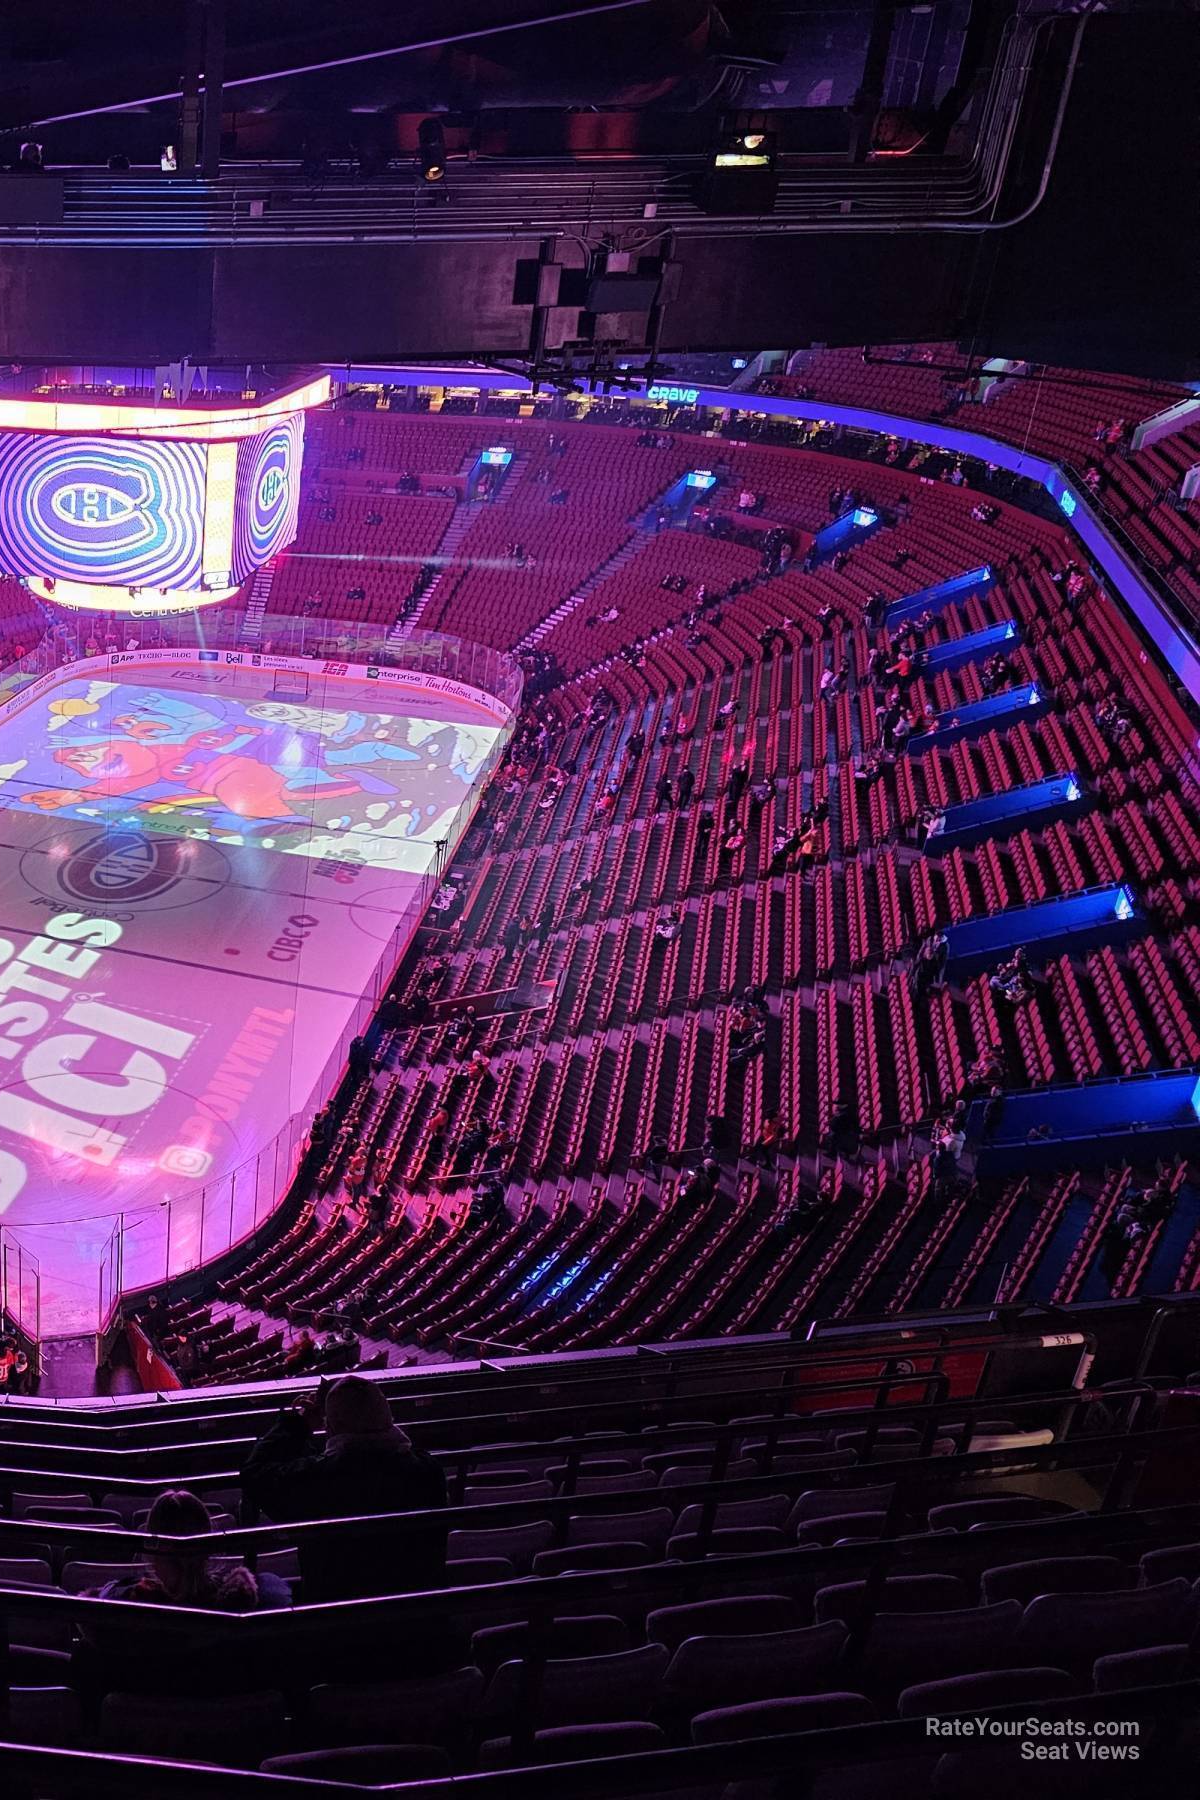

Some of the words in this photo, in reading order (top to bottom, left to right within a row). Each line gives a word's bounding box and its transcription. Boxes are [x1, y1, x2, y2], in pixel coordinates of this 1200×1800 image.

[225, 652, 243, 665] Bell
[321, 662, 349, 677] IGA
[424, 676, 441, 691] Tim
[441, 680, 472, 701] Hortons
[266, 927, 312, 963] CIBC
[1055, 1335, 1072, 1345] 326
